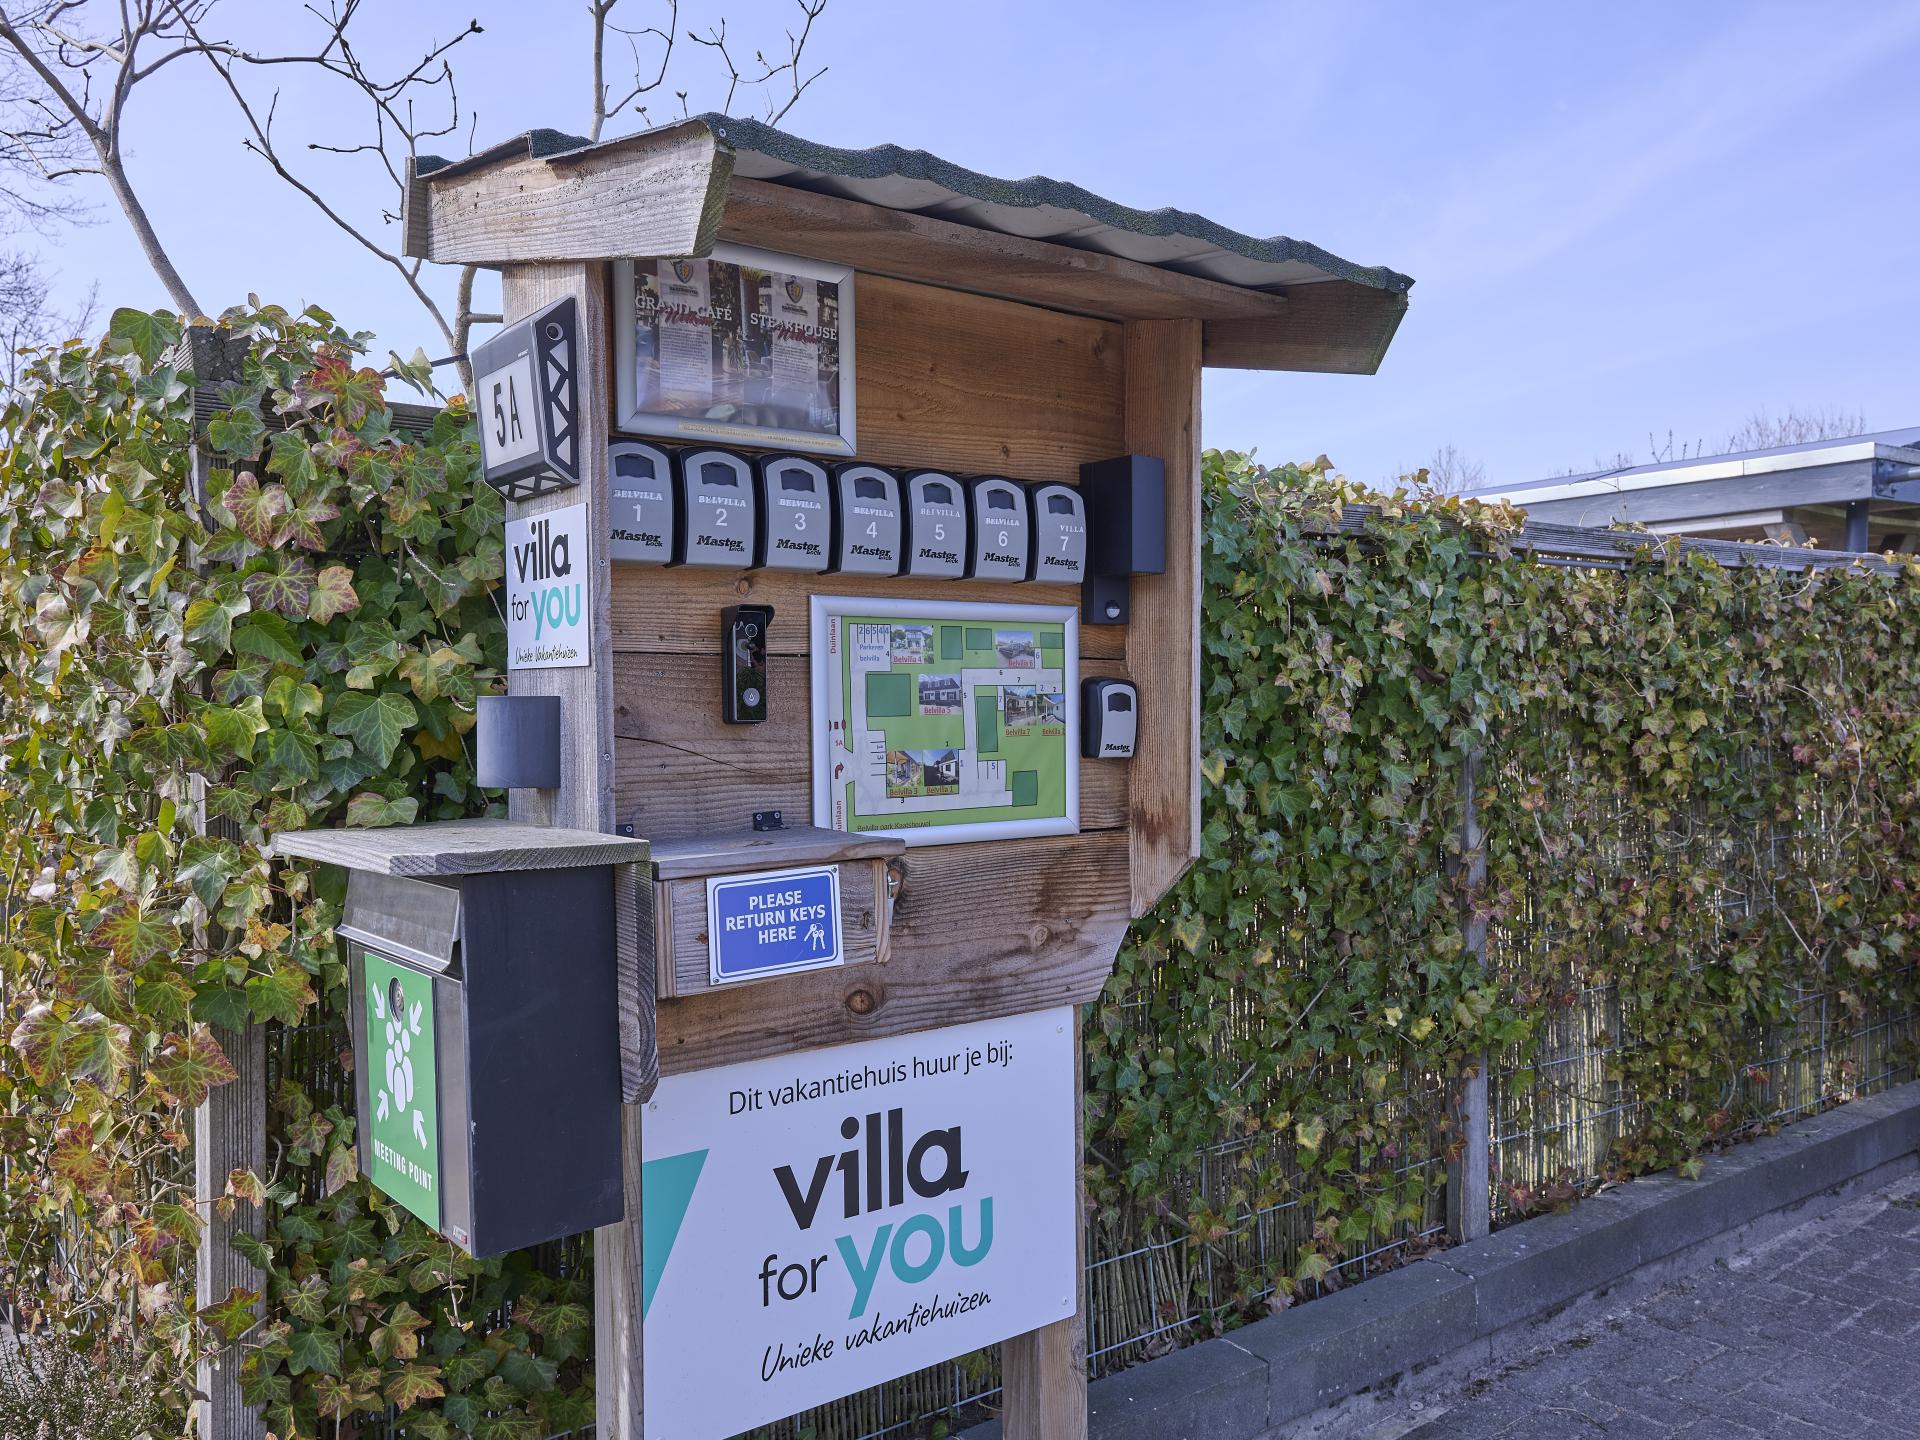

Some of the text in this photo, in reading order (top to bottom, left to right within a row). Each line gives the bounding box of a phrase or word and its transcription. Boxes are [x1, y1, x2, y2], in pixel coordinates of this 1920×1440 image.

[635, 295, 733, 321] GRAND CAFÉ
[750, 312, 838, 340] STEAKHOUSE
[493, 375, 523, 448] 5A
[698, 495, 747, 507] BELVILLA
[779, 498, 821, 510] BELVILLA
[632, 503, 641, 522] 1
[715, 508, 728, 527] 2
[853, 506, 894, 518] BELVILLA
[794, 512, 807, 531] 3
[866, 521, 878, 539] 4
[985, 517, 1020, 526] BELVILLA
[610, 529, 661, 542] Master
[935, 523, 945, 541] 5
[998, 530, 1008, 547] 6
[696, 535, 744, 547] Master
[776, 538, 820, 551] Master
[1060, 535, 1069, 552] 7
[513, 518, 572, 584] villa
[850, 544, 892, 557] Master
[919, 548, 957, 560] Master
[983, 552, 1020, 563] Master
[1044, 556, 1078, 567] Master
[511, 593, 529, 621] for
[829, 618, 837, 654] Duinlaan
[858, 626, 864, 635] 2
[865, 626, 871, 635] 6
[872, 626, 877, 635] 5
[878, 626, 884, 634] 4
[893, 655, 916, 663] Belvilla
[1035, 651, 1040, 659] 6
[924, 706, 946, 714] Belvilla
[889, 788, 913, 796] Belvilla
[926, 785, 949, 794] Belvilla
[749, 890, 802, 910] PLEASE
[725, 904, 826, 931] RETURN KEYS
[758, 925, 797, 944] HERE
[728, 1040, 1013, 1115] Dit vakantiehuis huur je bij:
[374, 1138, 433, 1192] MEETING POINT
[773, 1107, 970, 1231] villa
[758, 1253, 828, 1308] for
[761, 1291, 992, 1382] Unieke vakantiehuizen
